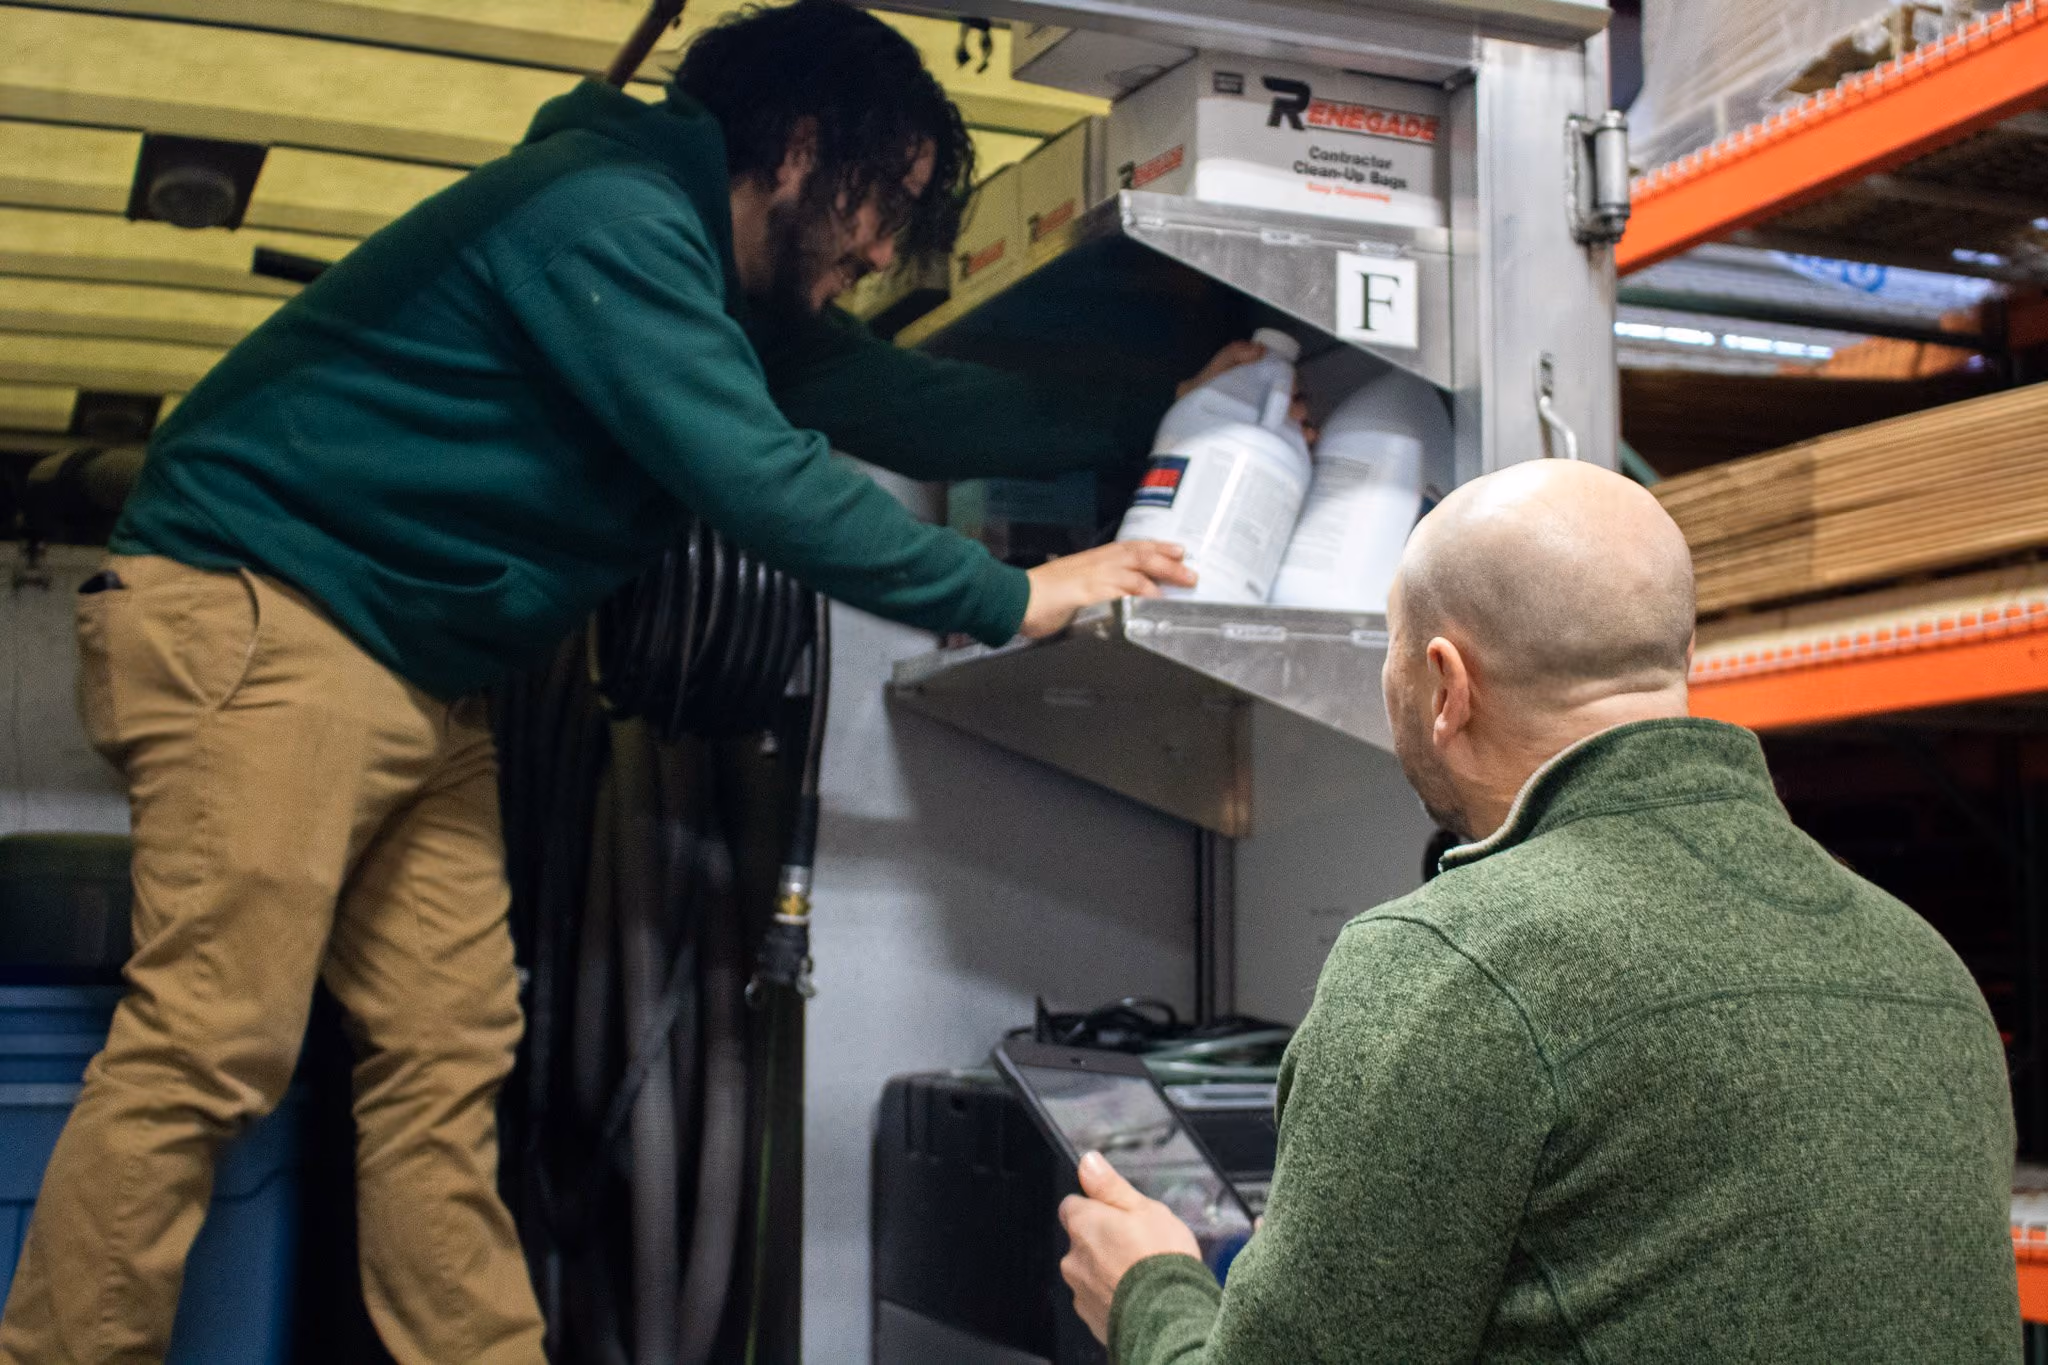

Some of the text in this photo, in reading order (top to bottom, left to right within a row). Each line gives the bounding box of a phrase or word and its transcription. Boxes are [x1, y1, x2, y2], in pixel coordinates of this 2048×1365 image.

[1262, 76, 1439, 142] RENEGADE
[1293, 160, 1407, 190] Clean-Up Bags
[1308, 145, 1392, 169] Contractor
[1353, 269, 1402, 331] F
